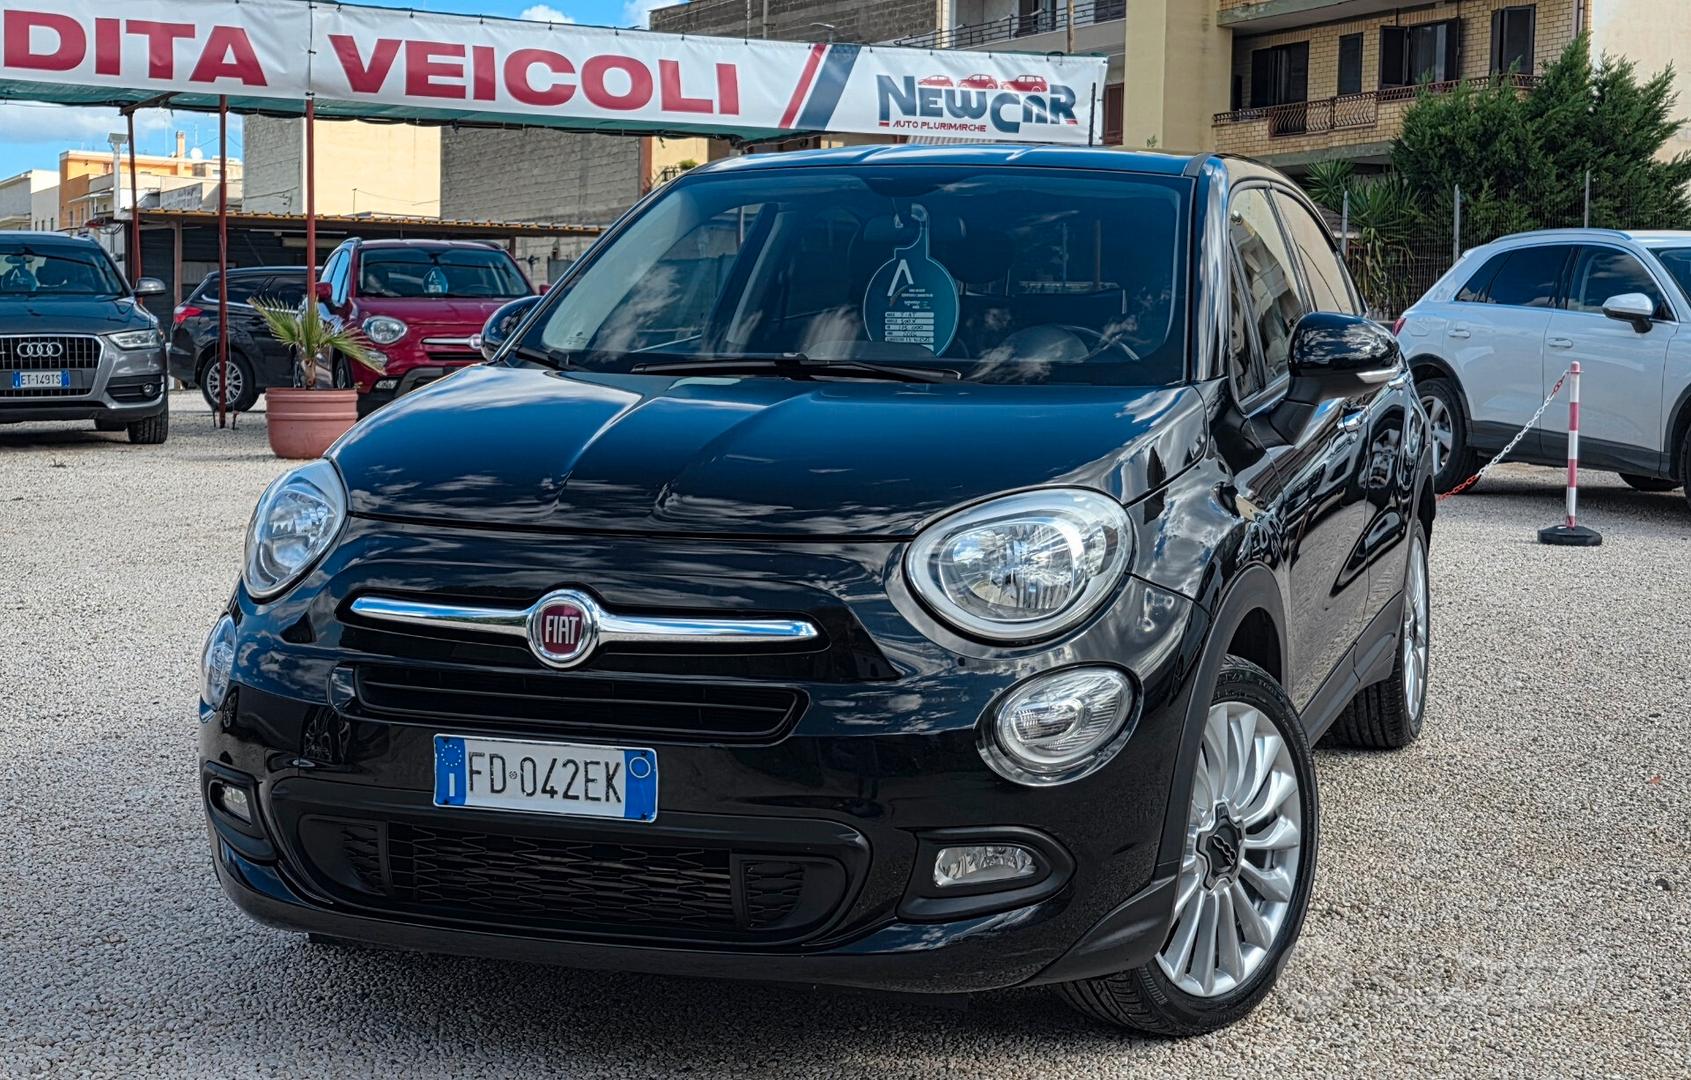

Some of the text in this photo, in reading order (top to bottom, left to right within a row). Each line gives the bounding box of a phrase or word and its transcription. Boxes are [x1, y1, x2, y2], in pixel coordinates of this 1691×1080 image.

[3, 8, 741, 115] DITA VEICOLI
[892, 120, 986, 133] AUTO PLURIMARCHE
[544, 616, 580, 645] FIAT
